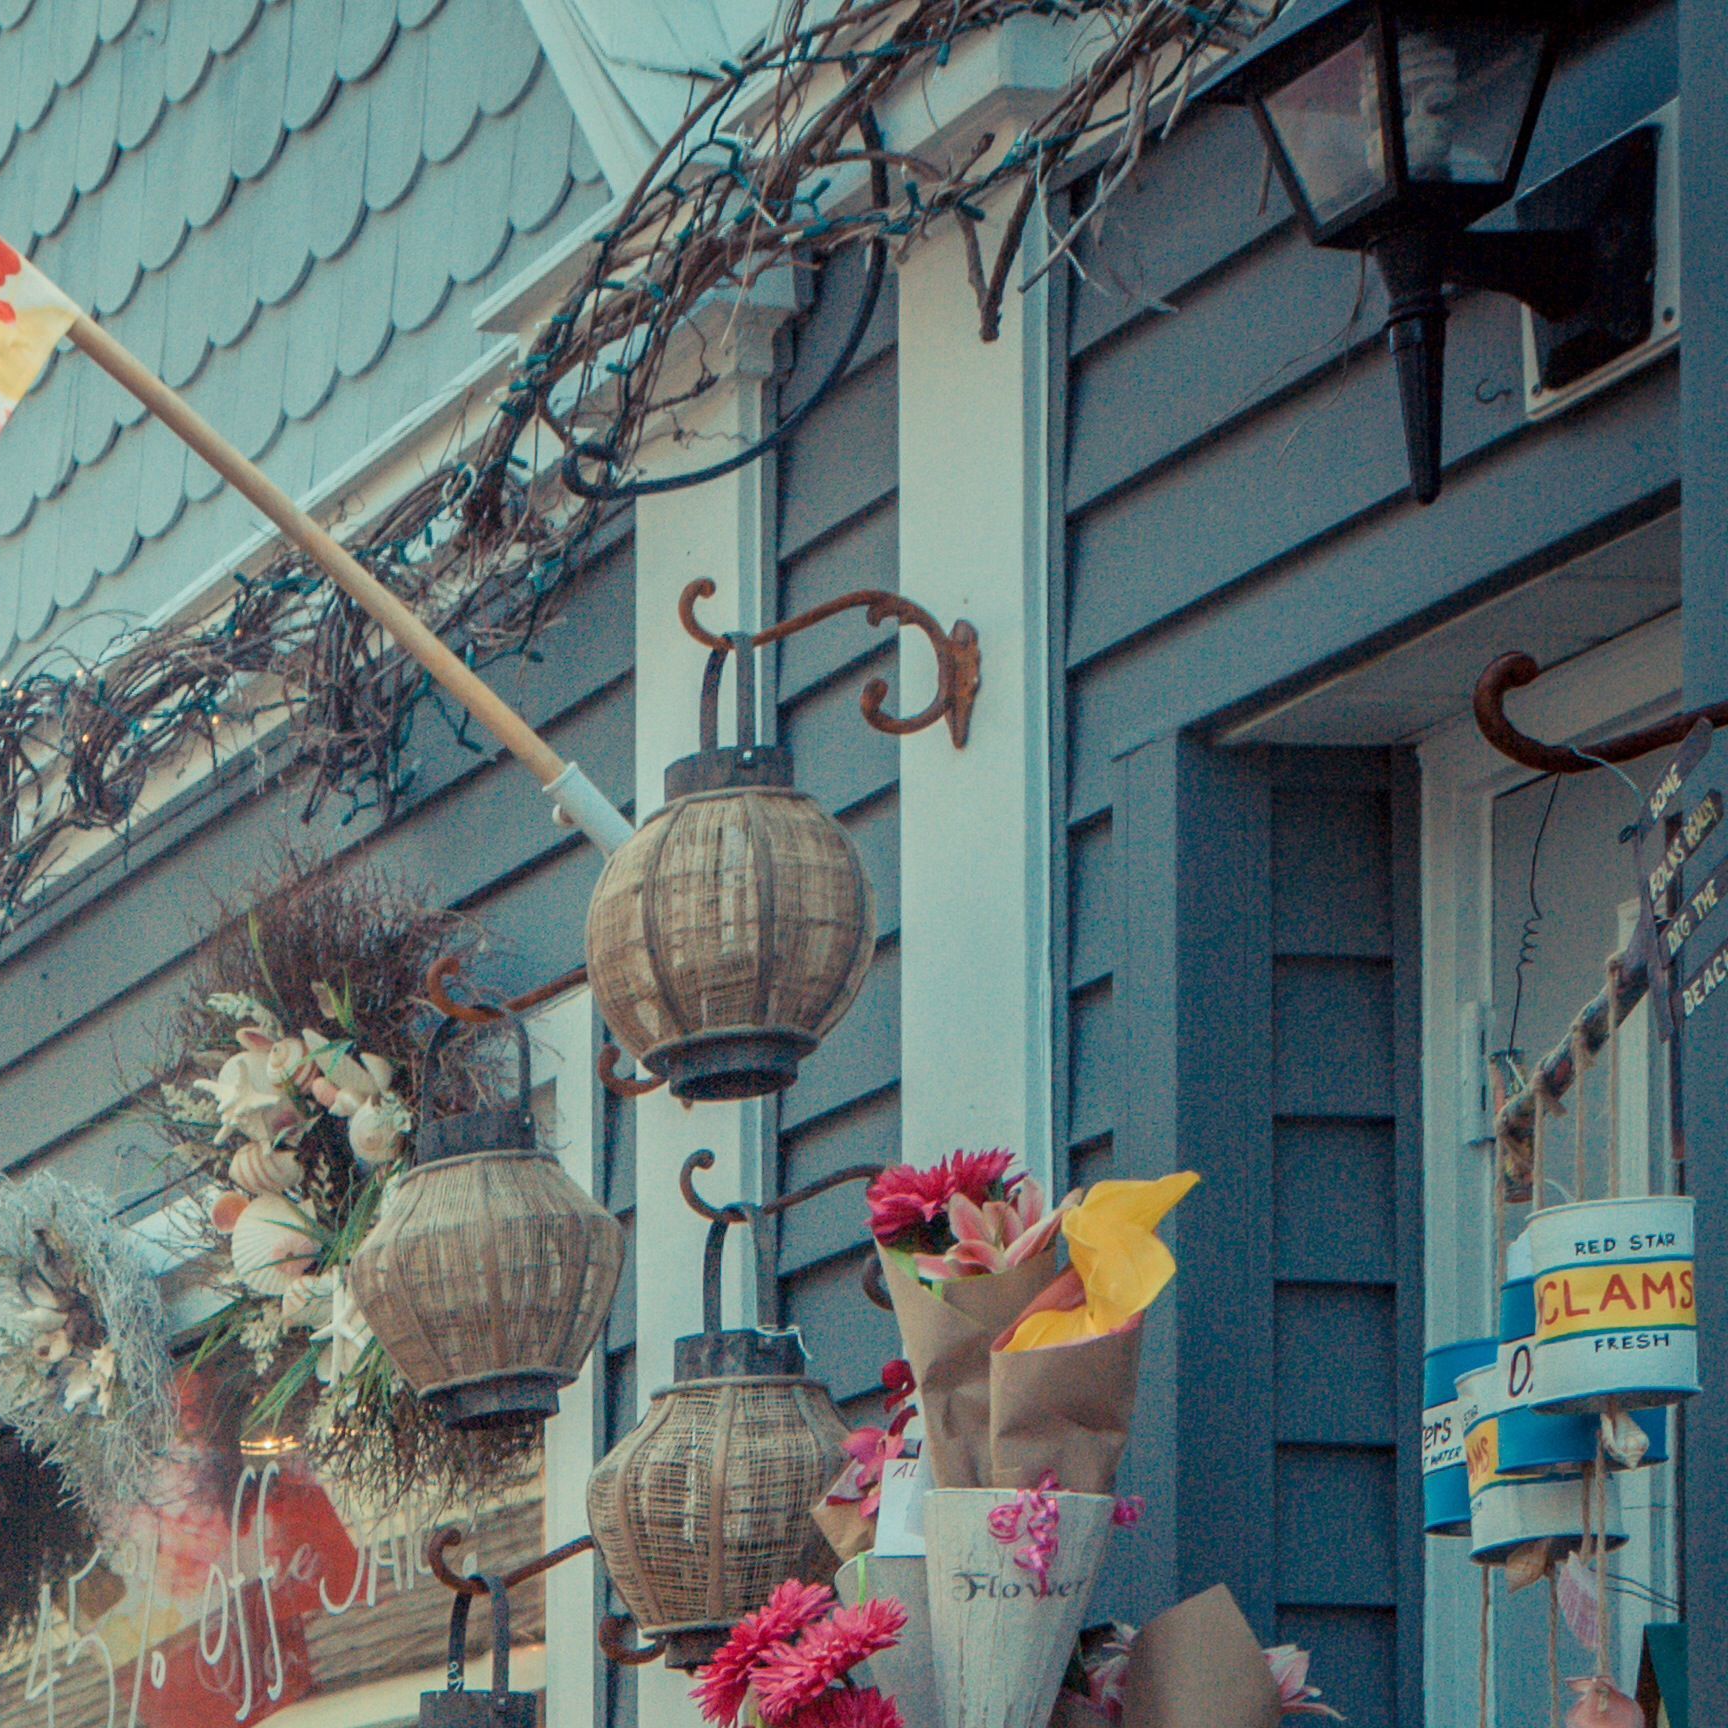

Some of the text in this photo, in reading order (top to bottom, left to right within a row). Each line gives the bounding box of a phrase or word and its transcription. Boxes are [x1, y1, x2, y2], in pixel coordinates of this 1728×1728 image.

[1651, 763, 1682, 818] SOME
[1667, 878, 1718, 955] DIG THE
[1574, 1232, 1676, 1256] RED STAR
[1542, 1270, 1694, 1326] CLAMS
[1594, 1333, 1670, 1353] FRESH
[200, 1461, 285, 1721] off
[952, 1571, 1088, 1602] Flower
